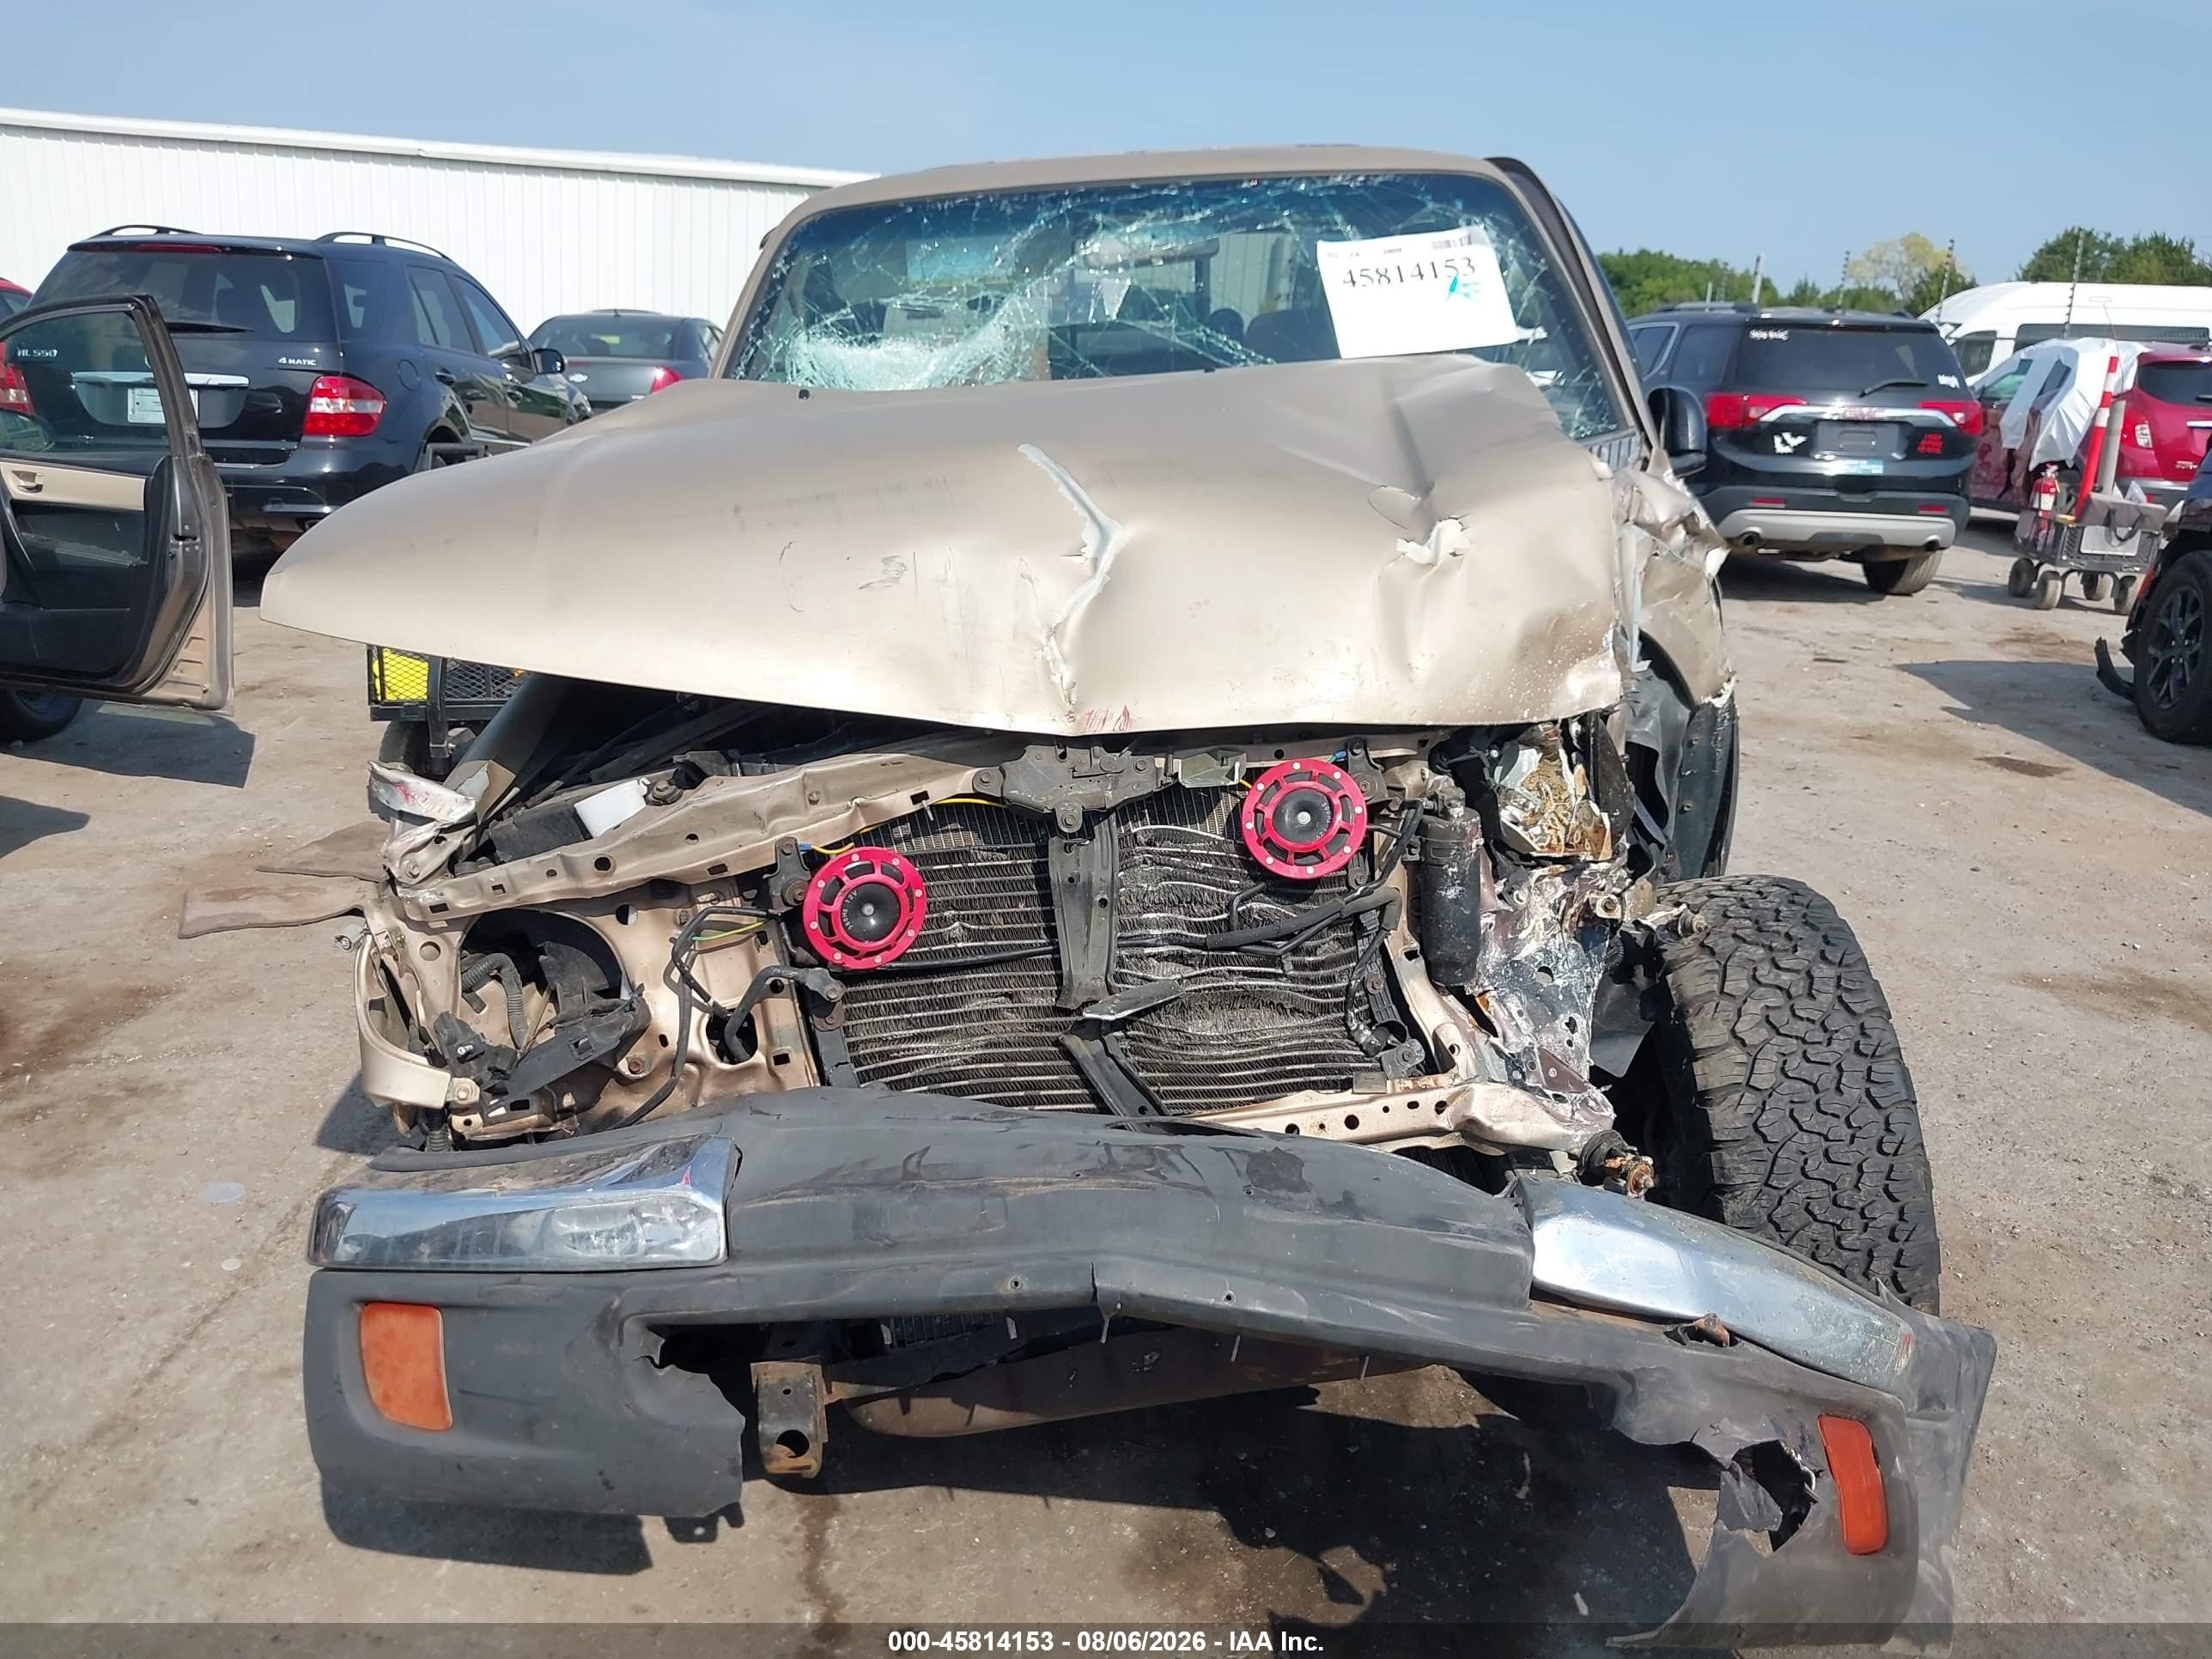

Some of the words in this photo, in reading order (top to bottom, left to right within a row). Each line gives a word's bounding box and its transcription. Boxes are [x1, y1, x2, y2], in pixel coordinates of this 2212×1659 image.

[1342, 256, 1476, 288] 45814153
[33, 349, 58, 357] 550
[1842, 406, 1884, 421] GMC
[844, 890, 858, 903] 12V
